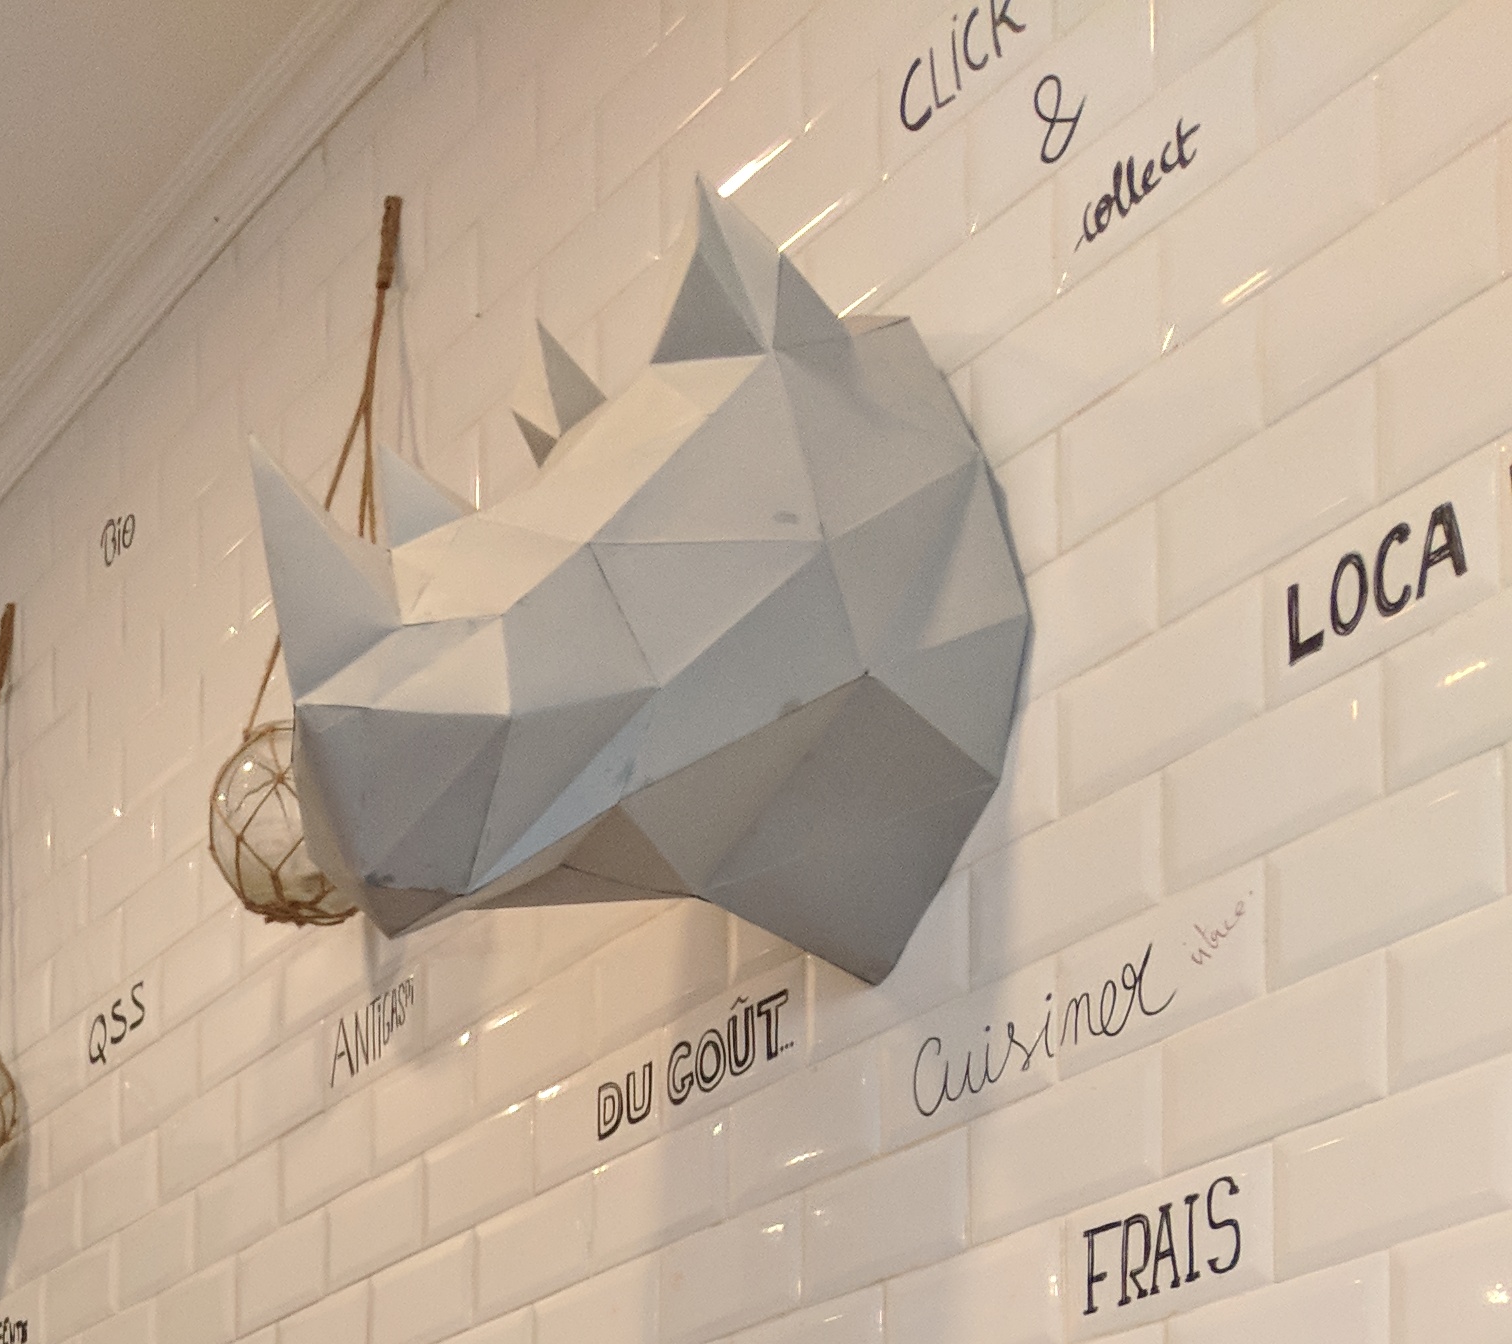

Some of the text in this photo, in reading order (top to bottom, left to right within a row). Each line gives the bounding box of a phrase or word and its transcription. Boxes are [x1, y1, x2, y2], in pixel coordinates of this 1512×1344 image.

[1033, 74, 1087, 164] &
[1074, 117, 1201, 253] collect
[88, 982, 146, 1066] QSS
[597, 1060, 653, 1141] DU
[1082, 1175, 1242, 1316] FRAIS
